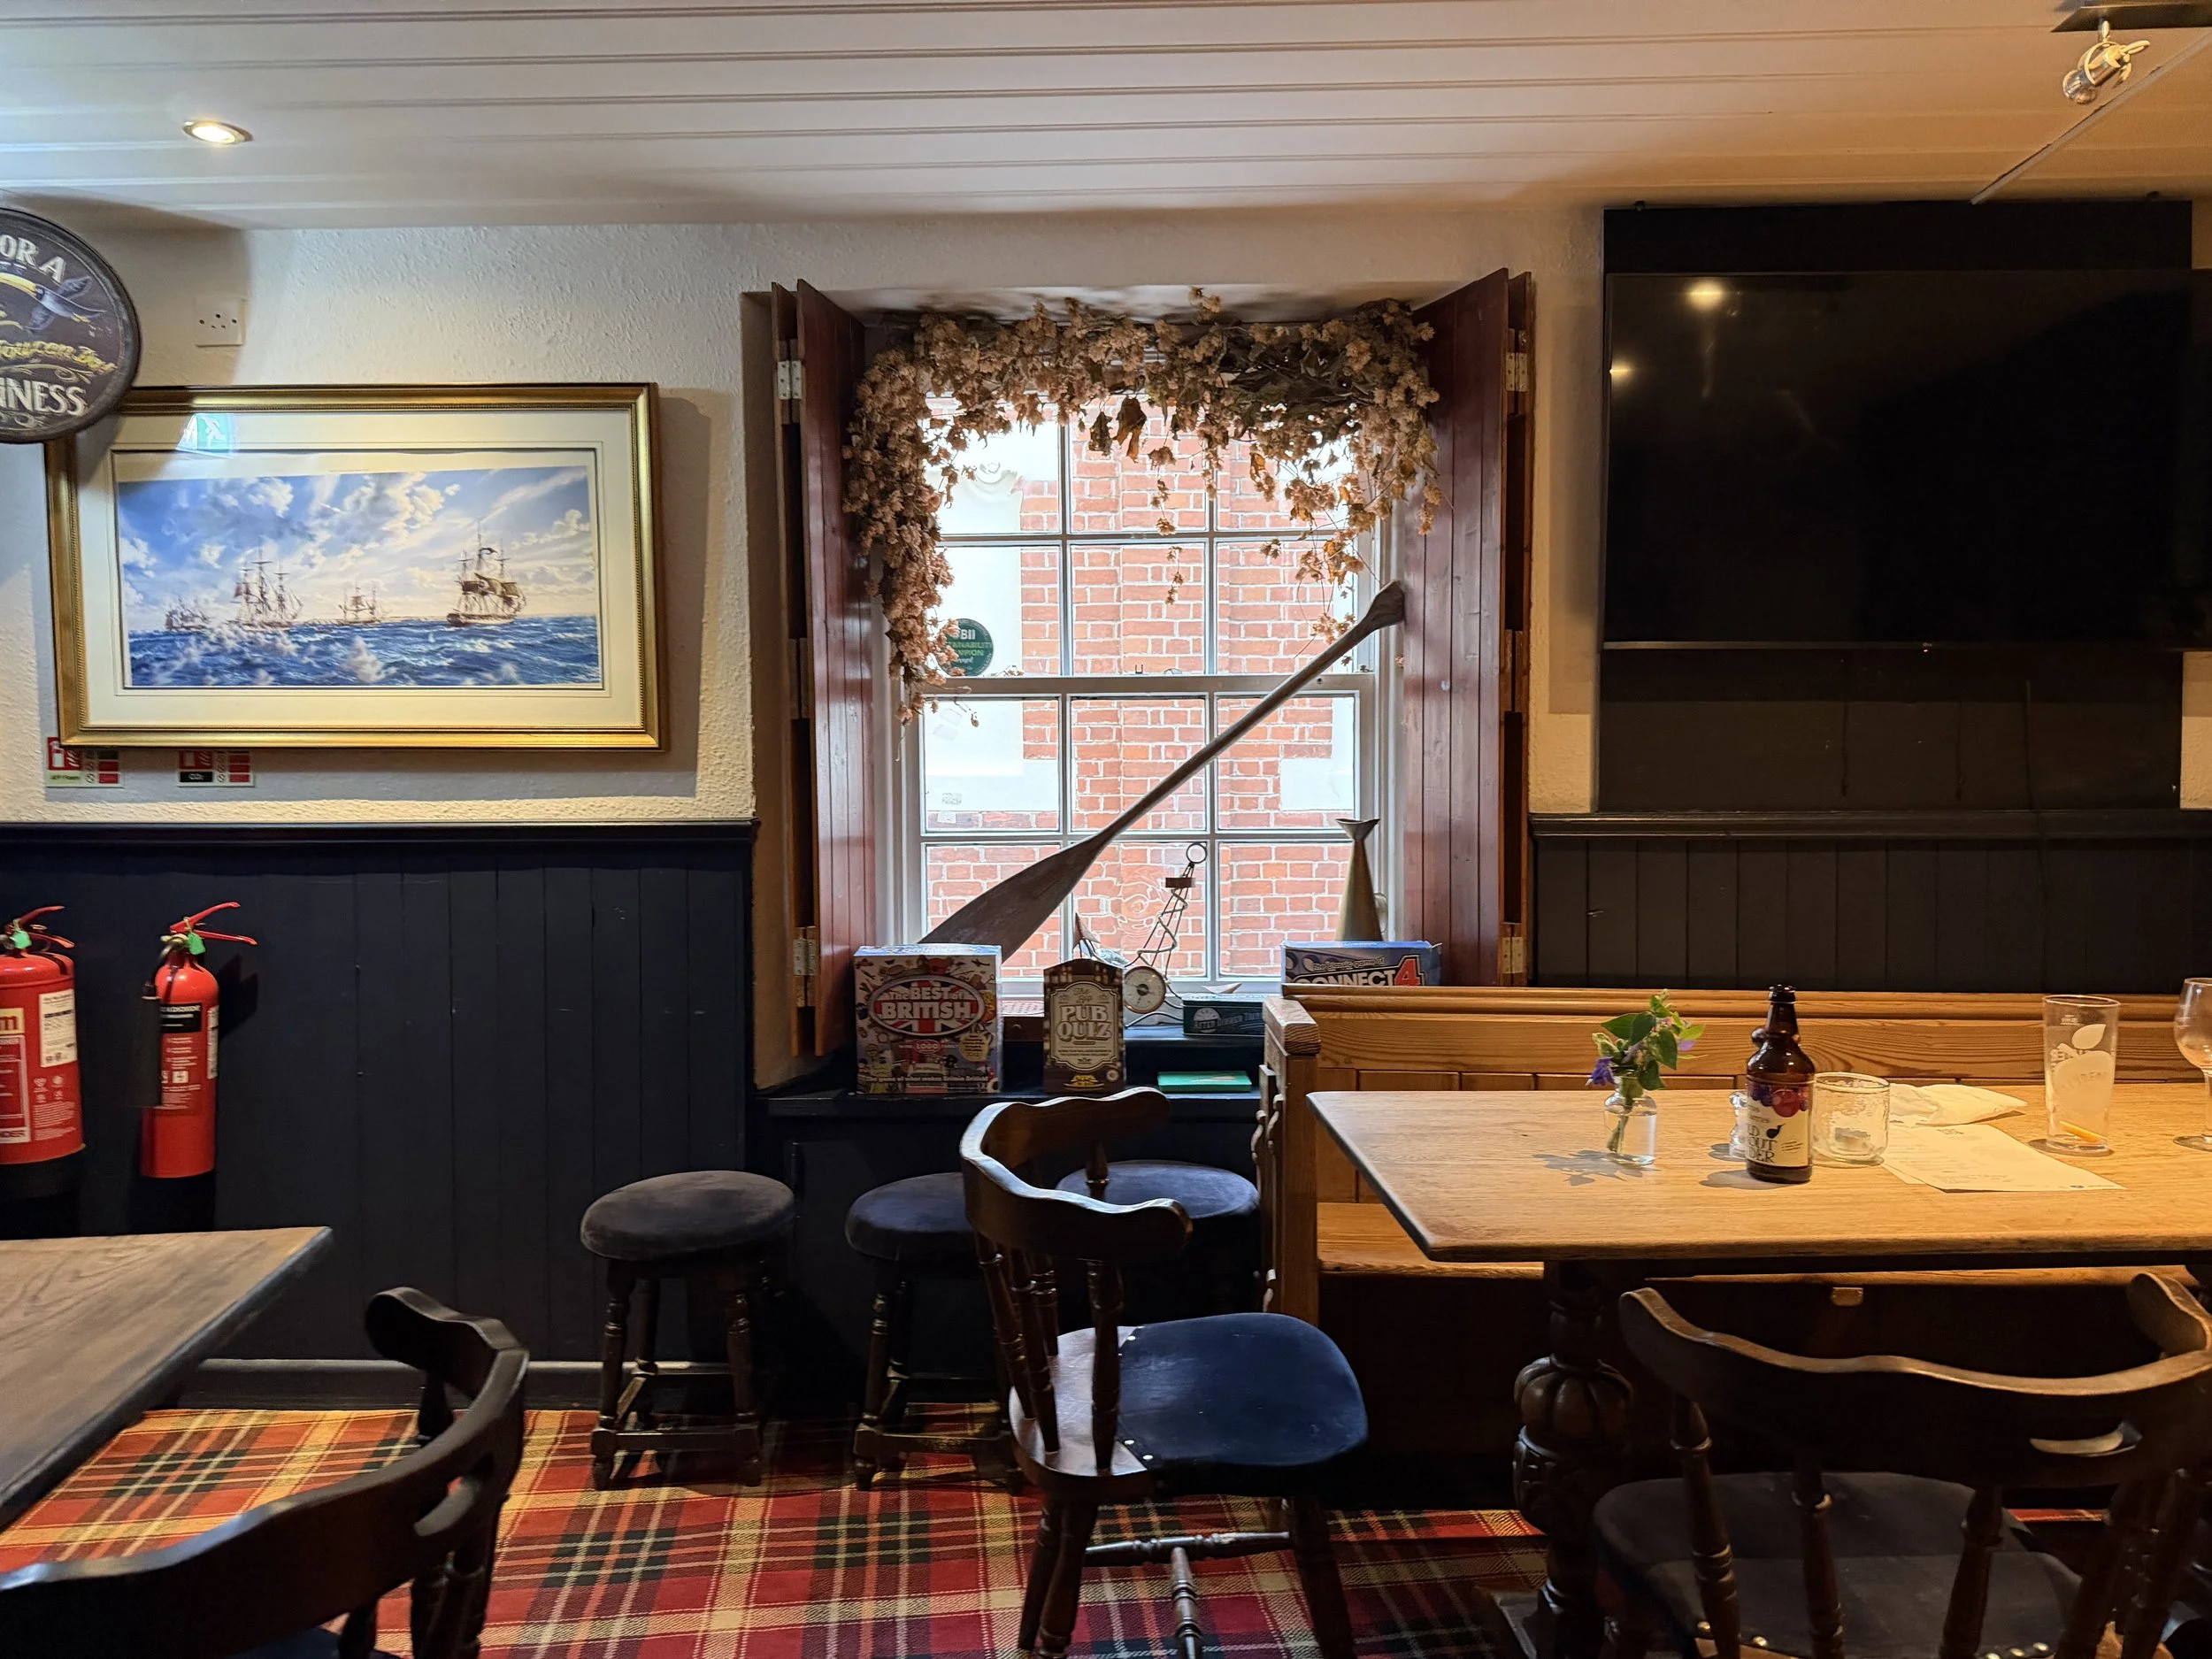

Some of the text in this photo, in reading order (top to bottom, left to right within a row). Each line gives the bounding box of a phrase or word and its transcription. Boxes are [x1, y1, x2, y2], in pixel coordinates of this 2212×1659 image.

[0, 234, 66, 284] OR A
[0, 377, 86, 417] NESS
[1394, 958, 1421, 986] 4
[910, 987, 949, 1001] BEST
[881, 1002, 972, 1019] BRITISH
[1060, 1005, 1107, 1021] PUB
[1057, 1021, 1112, 1041] QUIZ
